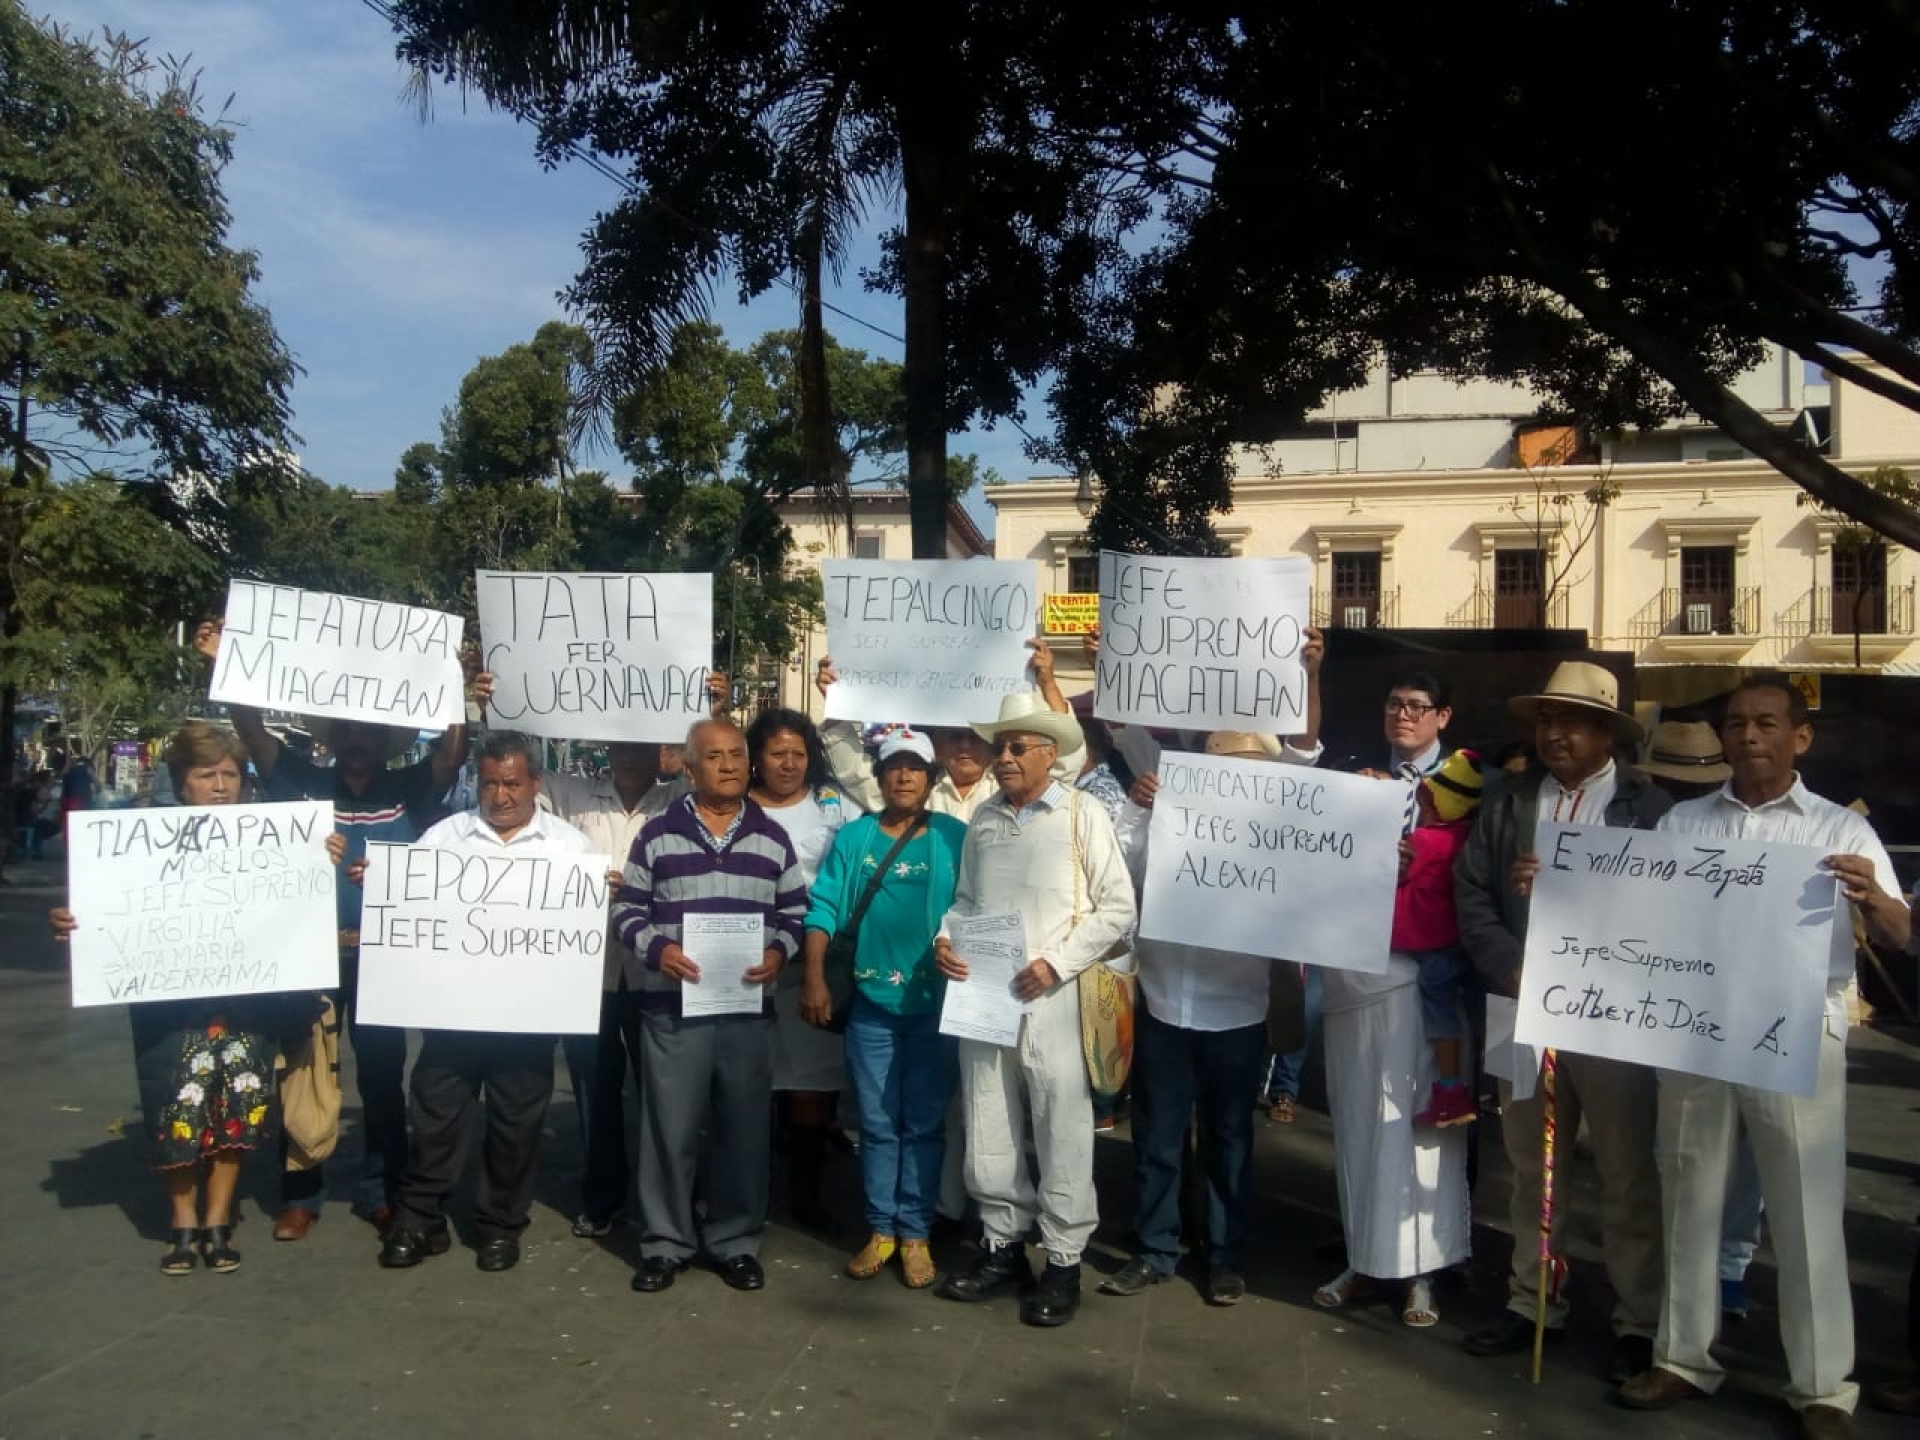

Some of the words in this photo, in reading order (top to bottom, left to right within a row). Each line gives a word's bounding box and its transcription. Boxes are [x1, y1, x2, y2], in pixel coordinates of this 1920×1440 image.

[486, 575, 659, 641] TATA
[830, 573, 1028, 633] TEPALCINGO
[1100, 551, 1186, 610] JEFE
[225, 581, 448, 660] JEFATURA
[1106, 603, 1300, 660] SUPREMO
[219, 637, 445, 717] MIACATLAN
[567, 640, 622, 663] FER
[1096, 660, 1304, 718] MIACATLAN
[1159, 762, 1325, 816] JONACATEPEC
[1175, 806, 1237, 843] JEFE
[1248, 820, 1354, 858] SUPREMO
[160, 848, 289, 883] MORELOS
[200, 867, 333, 906] SUPREMO
[369, 843, 610, 910] TEPOZTLAN
[1176, 850, 1276, 894] ALEXIA
[361, 905, 449, 951] JEFE
[461, 907, 603, 958] SUPREMO
